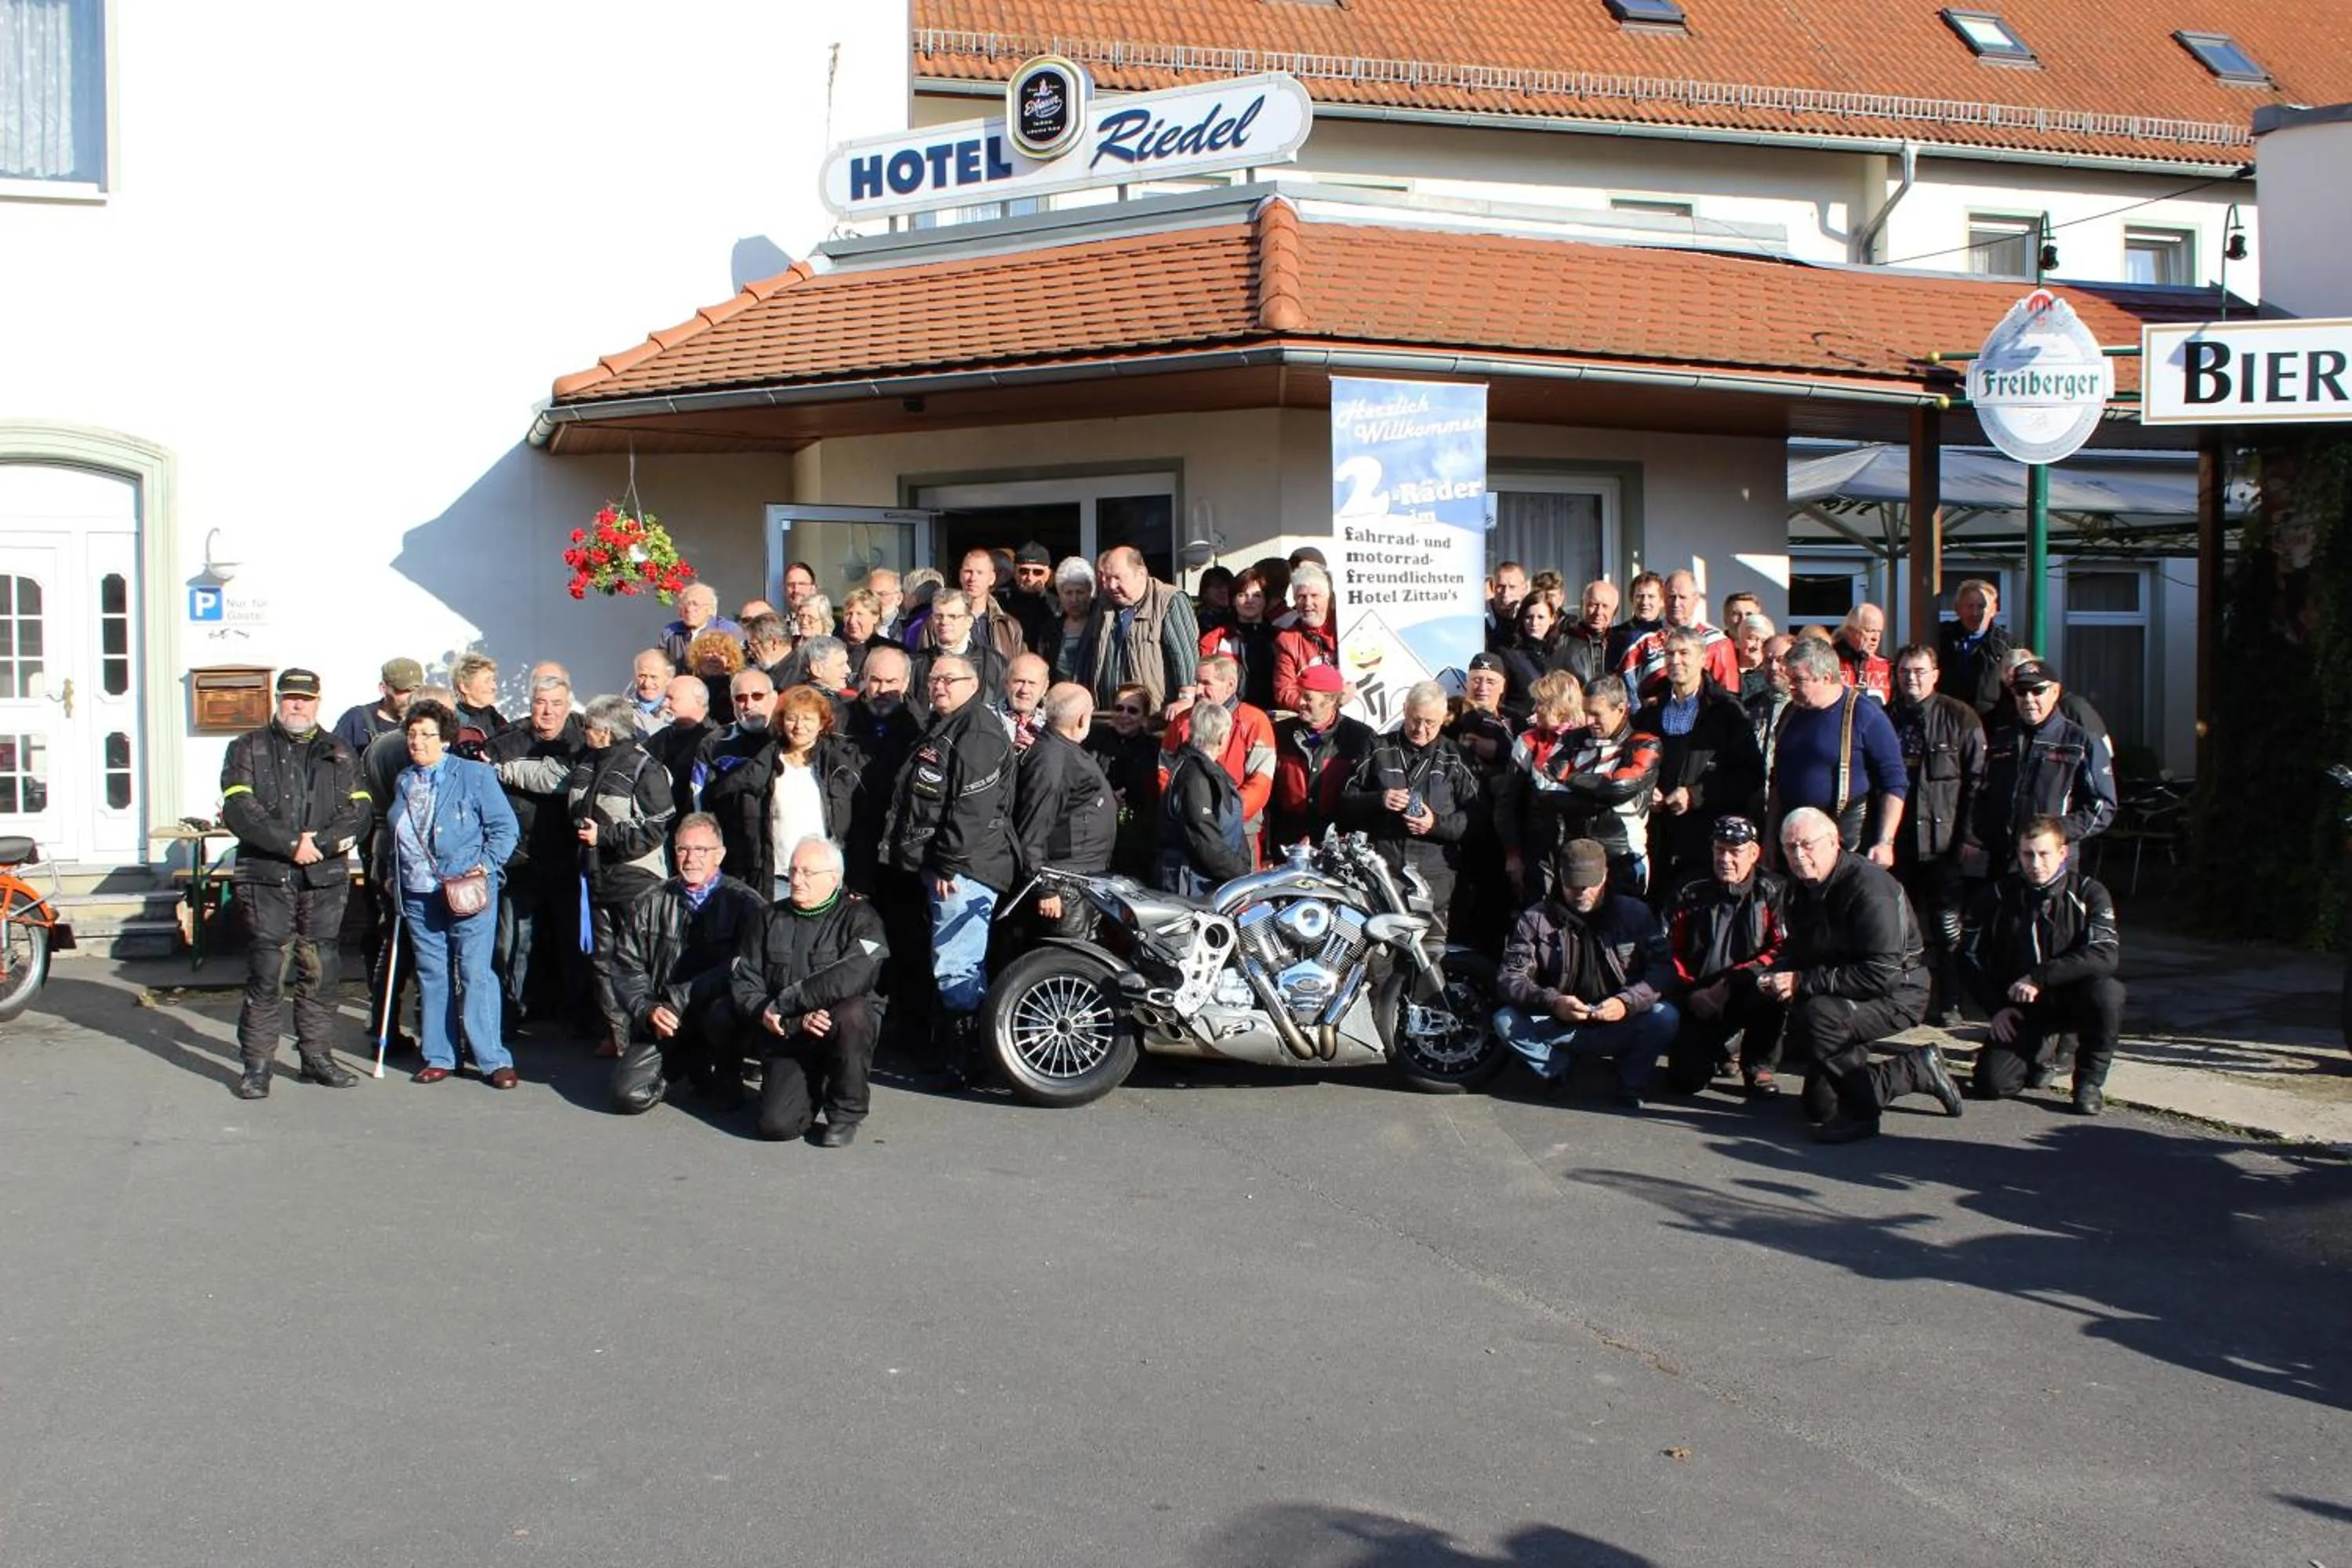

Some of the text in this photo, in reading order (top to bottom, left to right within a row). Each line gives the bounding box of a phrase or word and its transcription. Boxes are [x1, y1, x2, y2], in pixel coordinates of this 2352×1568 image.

[850, 94, 1265, 201] HOTEL Riedel
[1981, 369, 2100, 401] Freiberger
[2183, 341, 2349, 405] BIER
[1334, 392, 1429, 429] Herzlich
[1345, 526, 1451, 549] fahrrad- und
[1346, 551, 1434, 565] motorrad-
[1345, 569, 1465, 584] freundlichsten
[195, 591, 216, 617] P
[1348, 589, 1458, 604] Hotel Zittau's
